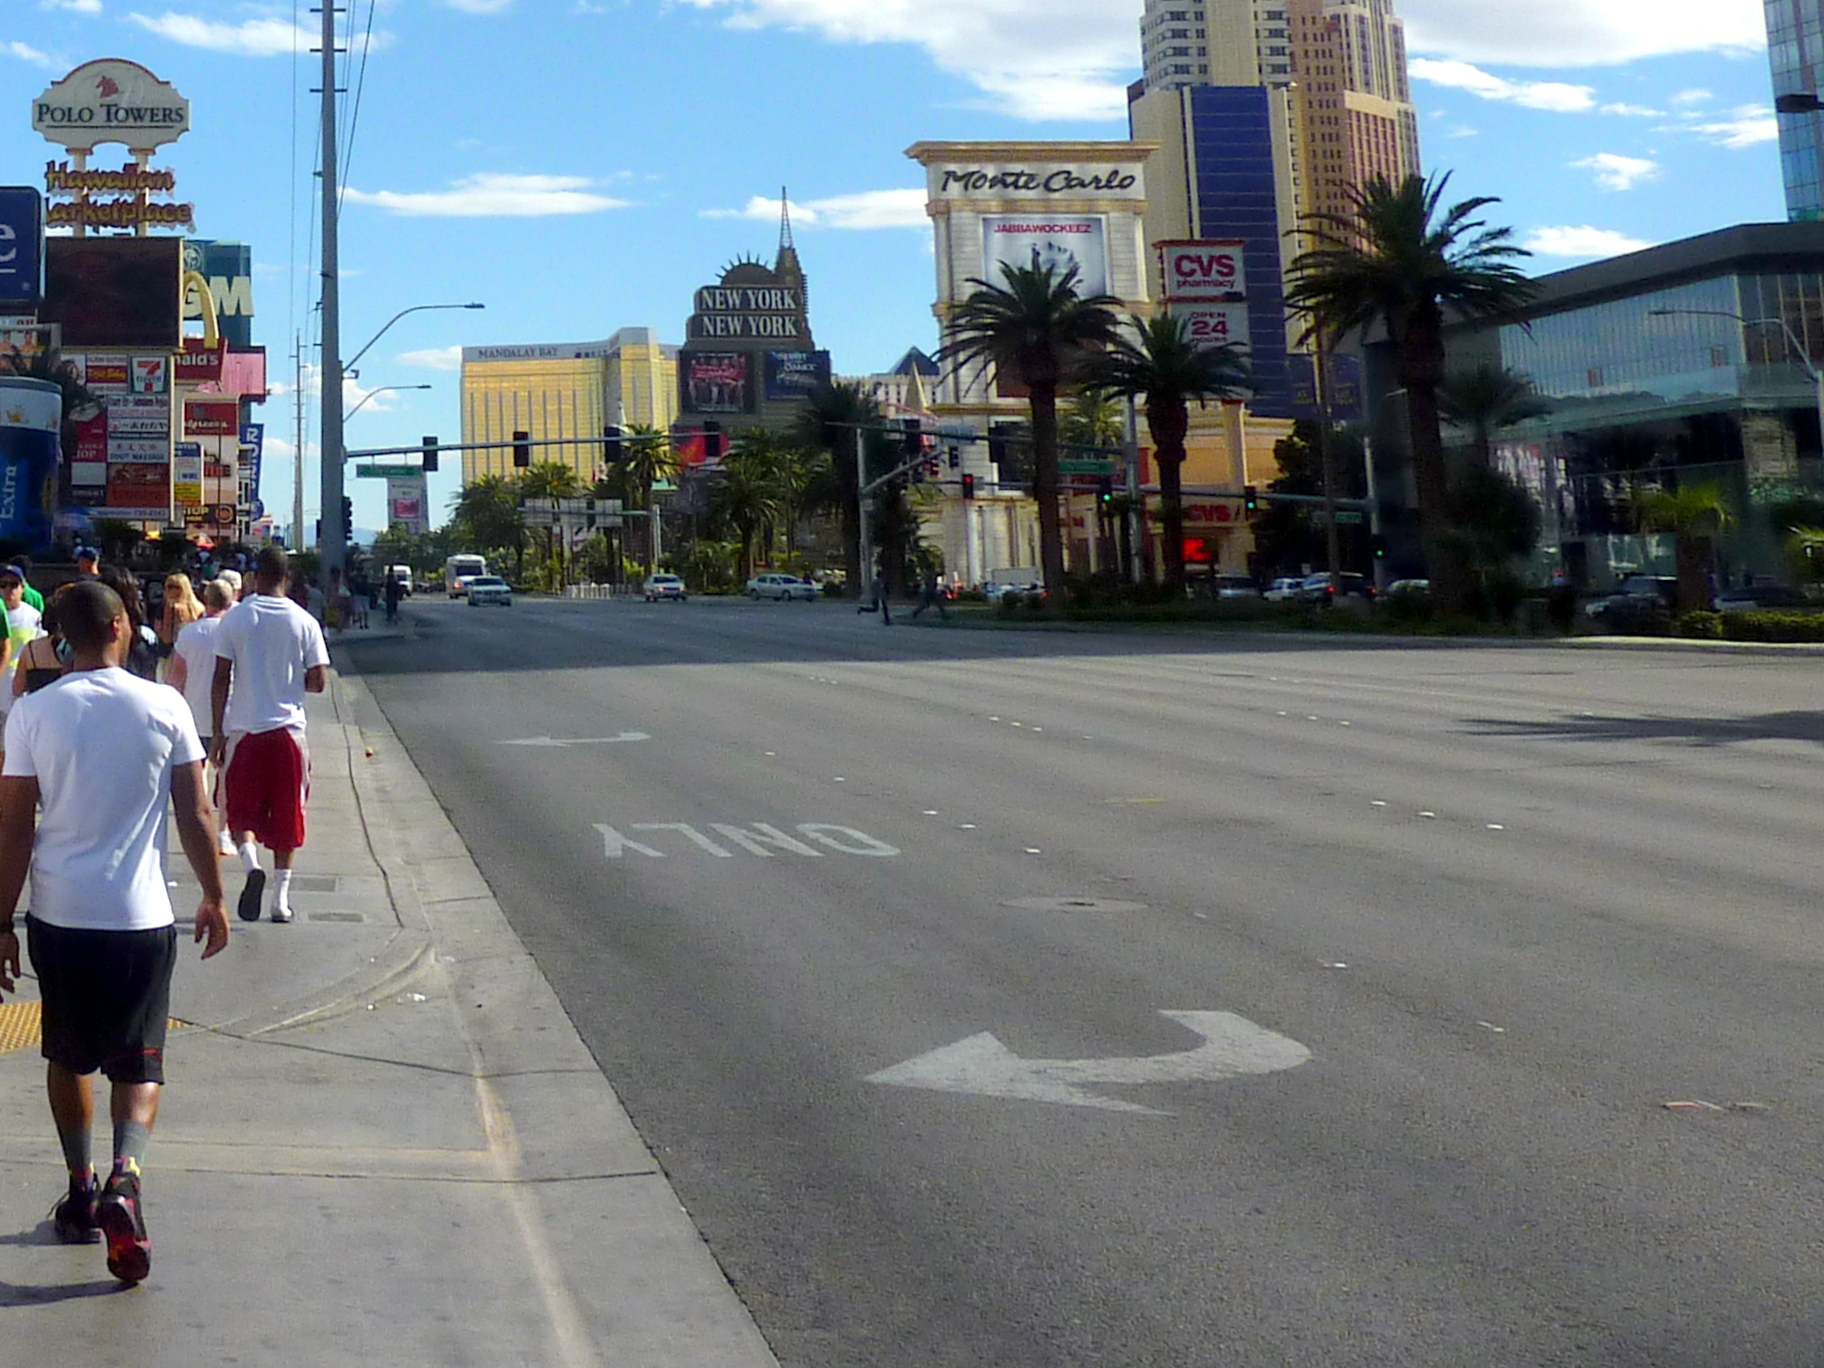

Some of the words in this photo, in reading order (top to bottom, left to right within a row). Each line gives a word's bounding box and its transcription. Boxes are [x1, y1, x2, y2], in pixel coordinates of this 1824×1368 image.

[37, 103, 94, 123] POLO
[100, 102, 184, 123] TOWERS
[45, 160, 176, 192] Hawaiian
[941, 169, 1043, 192] Monte
[1043, 169, 1136, 192] Carlo
[45, 193, 193, 229] arketplace
[994, 223, 1092, 234] JABBAWOCKEEZ
[1175, 254, 1236, 277] CVS
[1177, 279, 1236, 289] pharmacy
[702, 288, 742, 310] NEW
[747, 288, 796, 310] YORK
[703, 314, 742, 337] NEW
[748, 314, 797, 337] YORK
[1191, 320, 1229, 336] 24
[591, 822, 902, 858] ONLY
